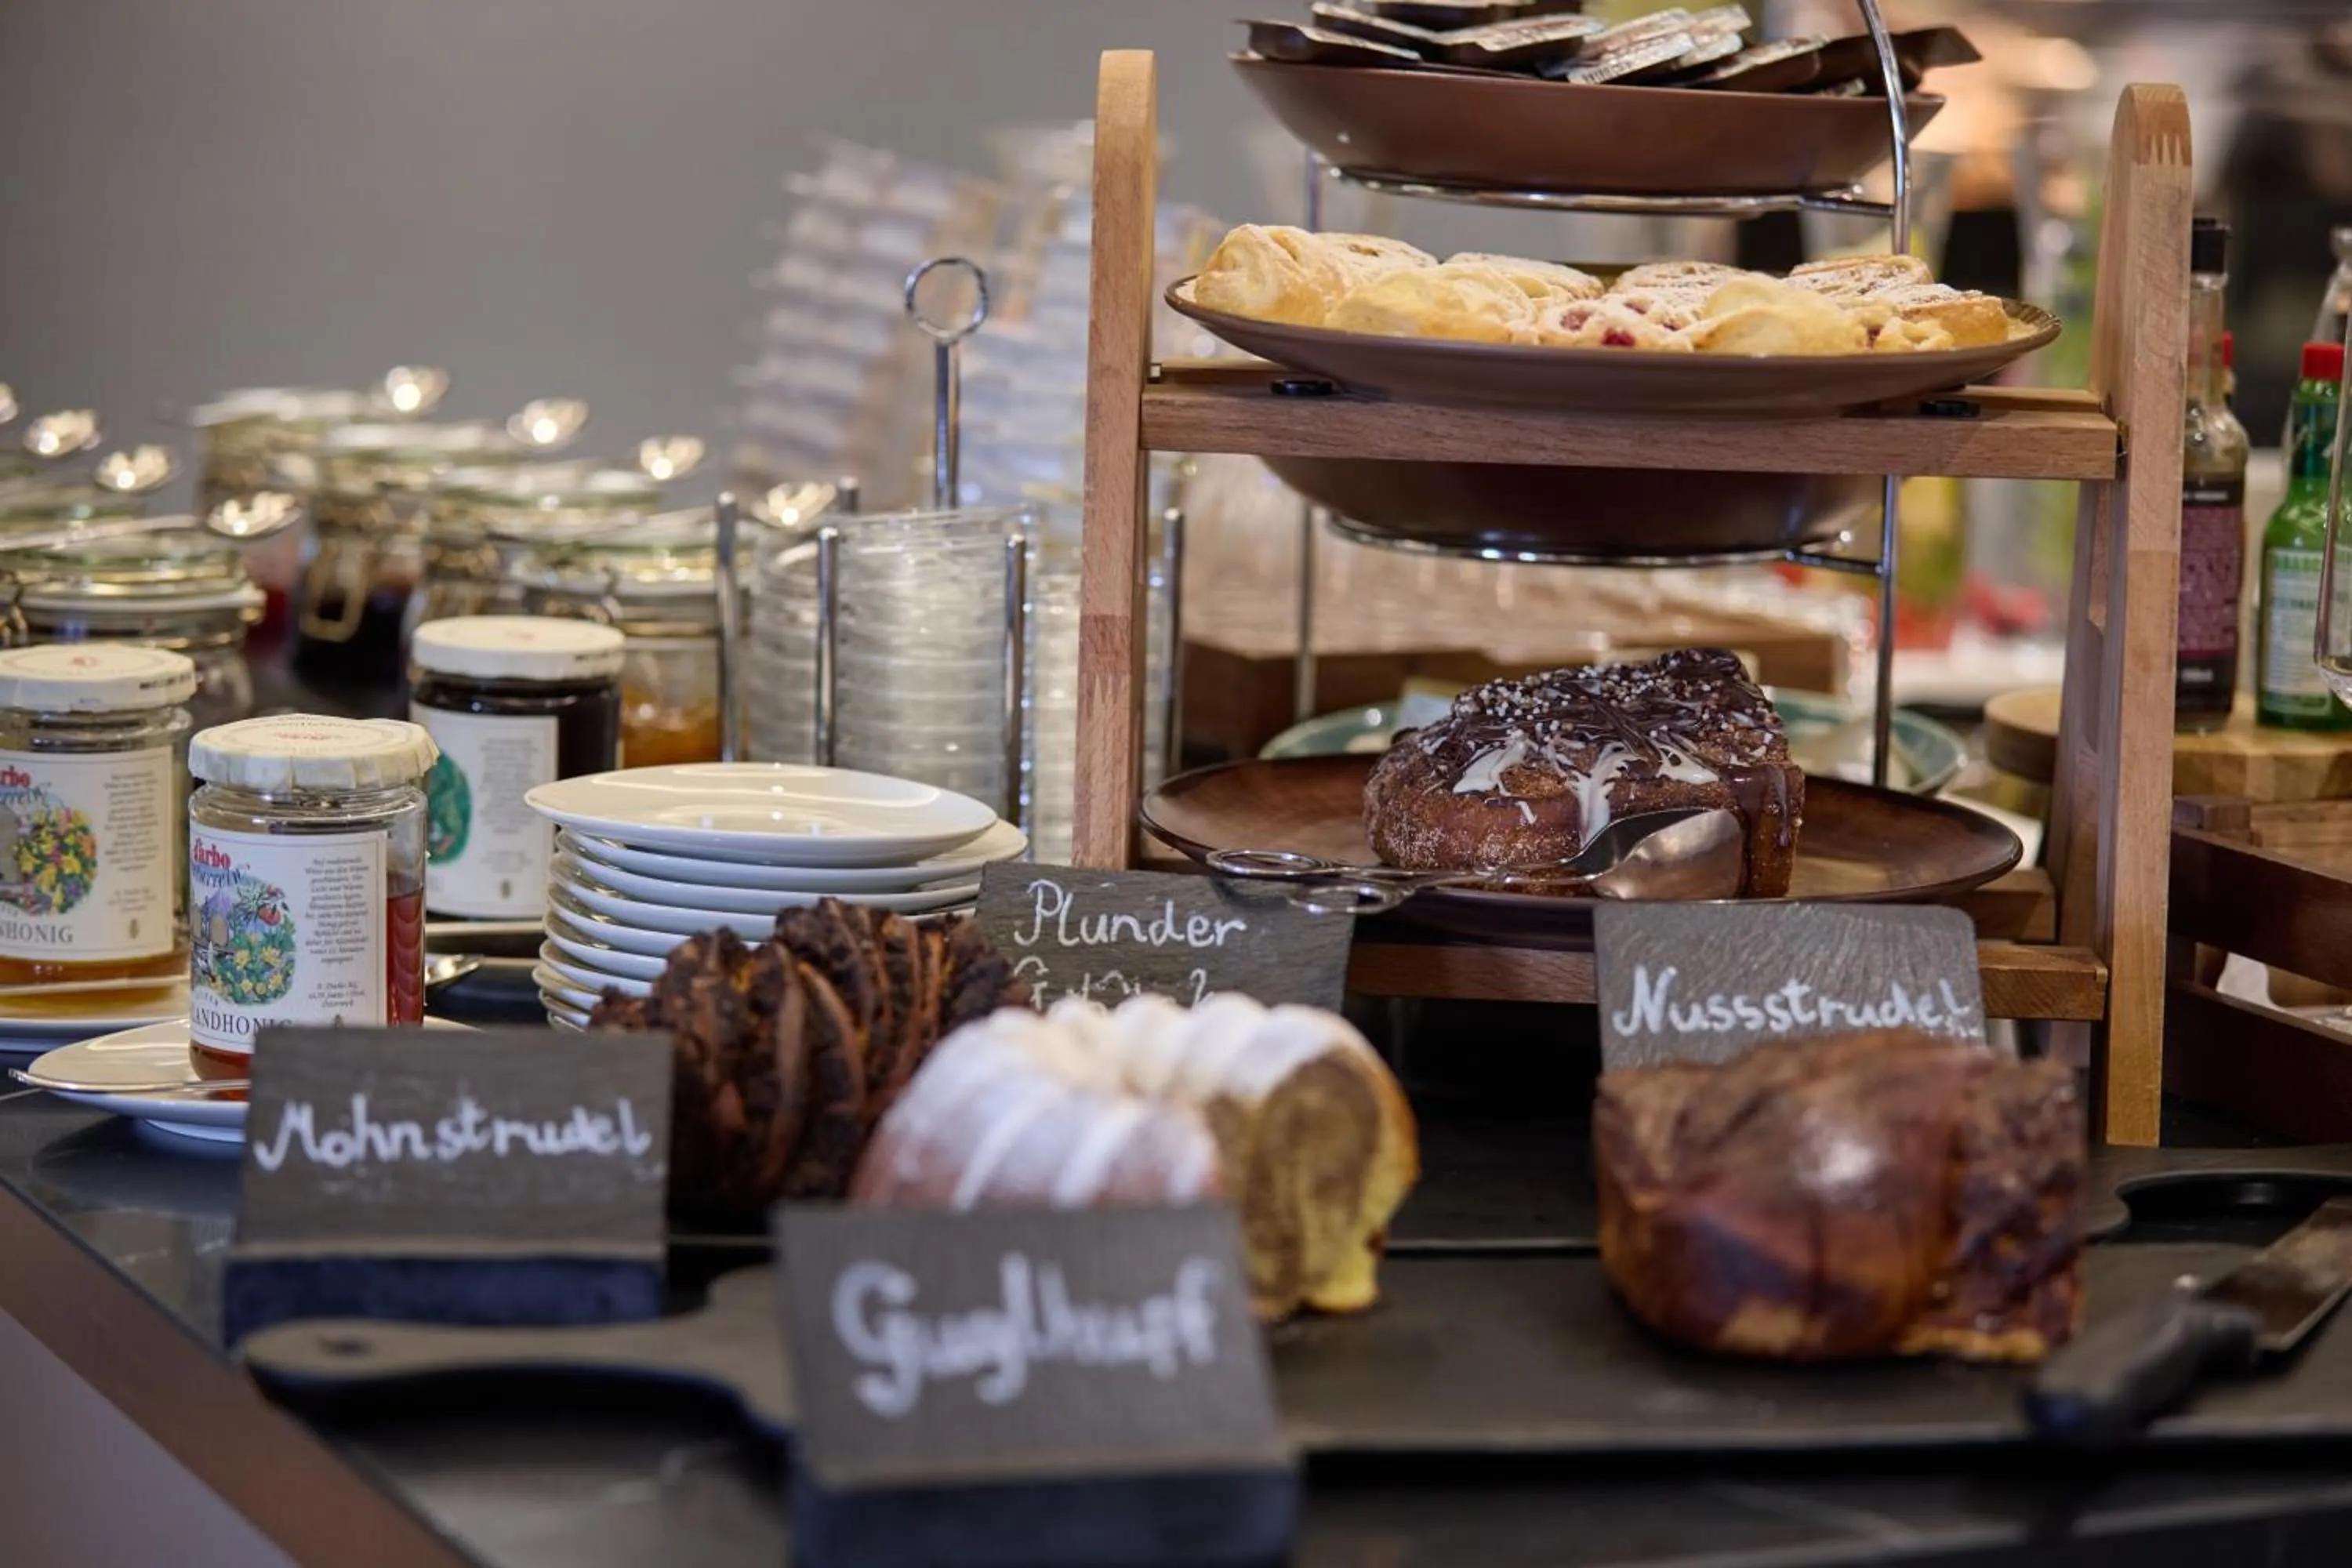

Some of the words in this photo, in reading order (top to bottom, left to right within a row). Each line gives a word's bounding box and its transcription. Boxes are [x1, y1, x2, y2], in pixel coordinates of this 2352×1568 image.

[1014, 878, 1247, 947] Plunder
[1612, 964, 1970, 1036] Nussstrudel
[253, 1092, 652, 1171] Mohnstrudel
